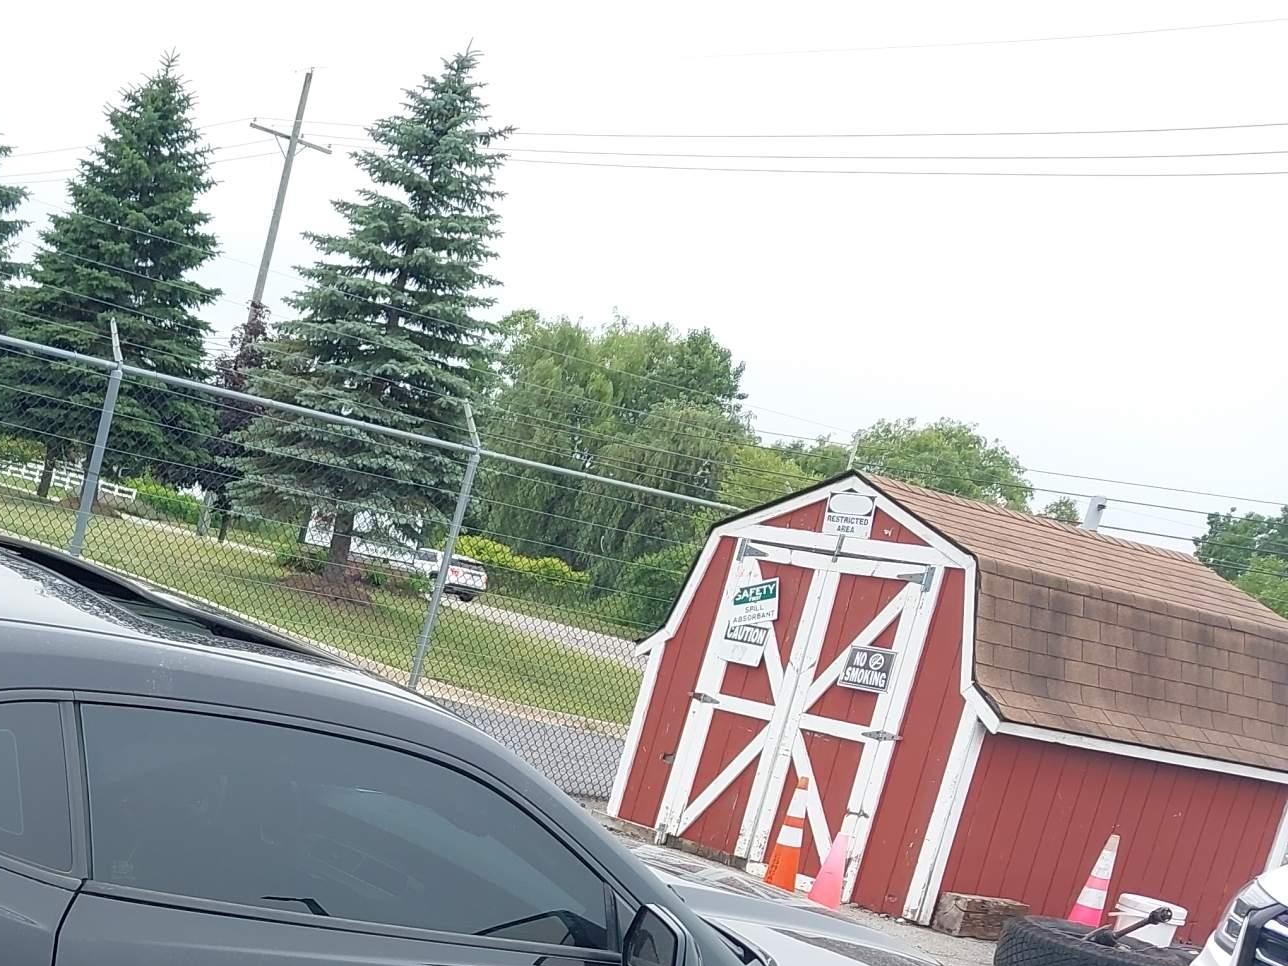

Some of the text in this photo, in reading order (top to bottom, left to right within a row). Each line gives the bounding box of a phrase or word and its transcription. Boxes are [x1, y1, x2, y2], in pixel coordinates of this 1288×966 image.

[827, 515, 869, 526] RESTRICTED
[836, 525, 855, 533] AREA
[734, 583, 776, 601] SAFETY
[745, 605, 764, 613] SPILL
[732, 610, 776, 623] ABSORBANT
[727, 625, 767, 645] CAUTION
[853, 651, 868, 667] NO
[844, 666, 887, 688] SMOKING
